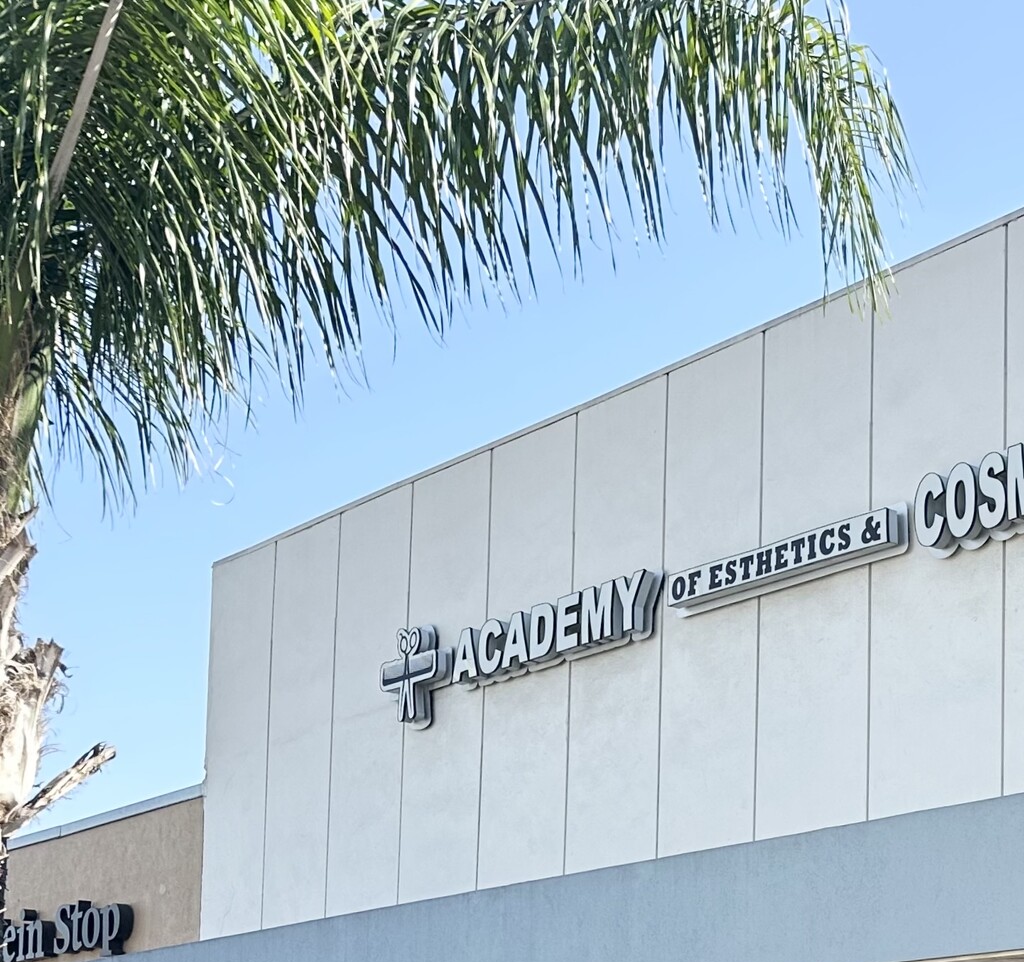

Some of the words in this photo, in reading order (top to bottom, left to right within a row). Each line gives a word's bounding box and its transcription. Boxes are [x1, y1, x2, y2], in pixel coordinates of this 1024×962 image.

[451, 568, 650, 684] ACADEMY
[672, 569, 702, 601] OF
[708, 522, 851, 591] ESTHETICS
[860, 515, 881, 545] &
[53, 900, 121, 957] Stop
